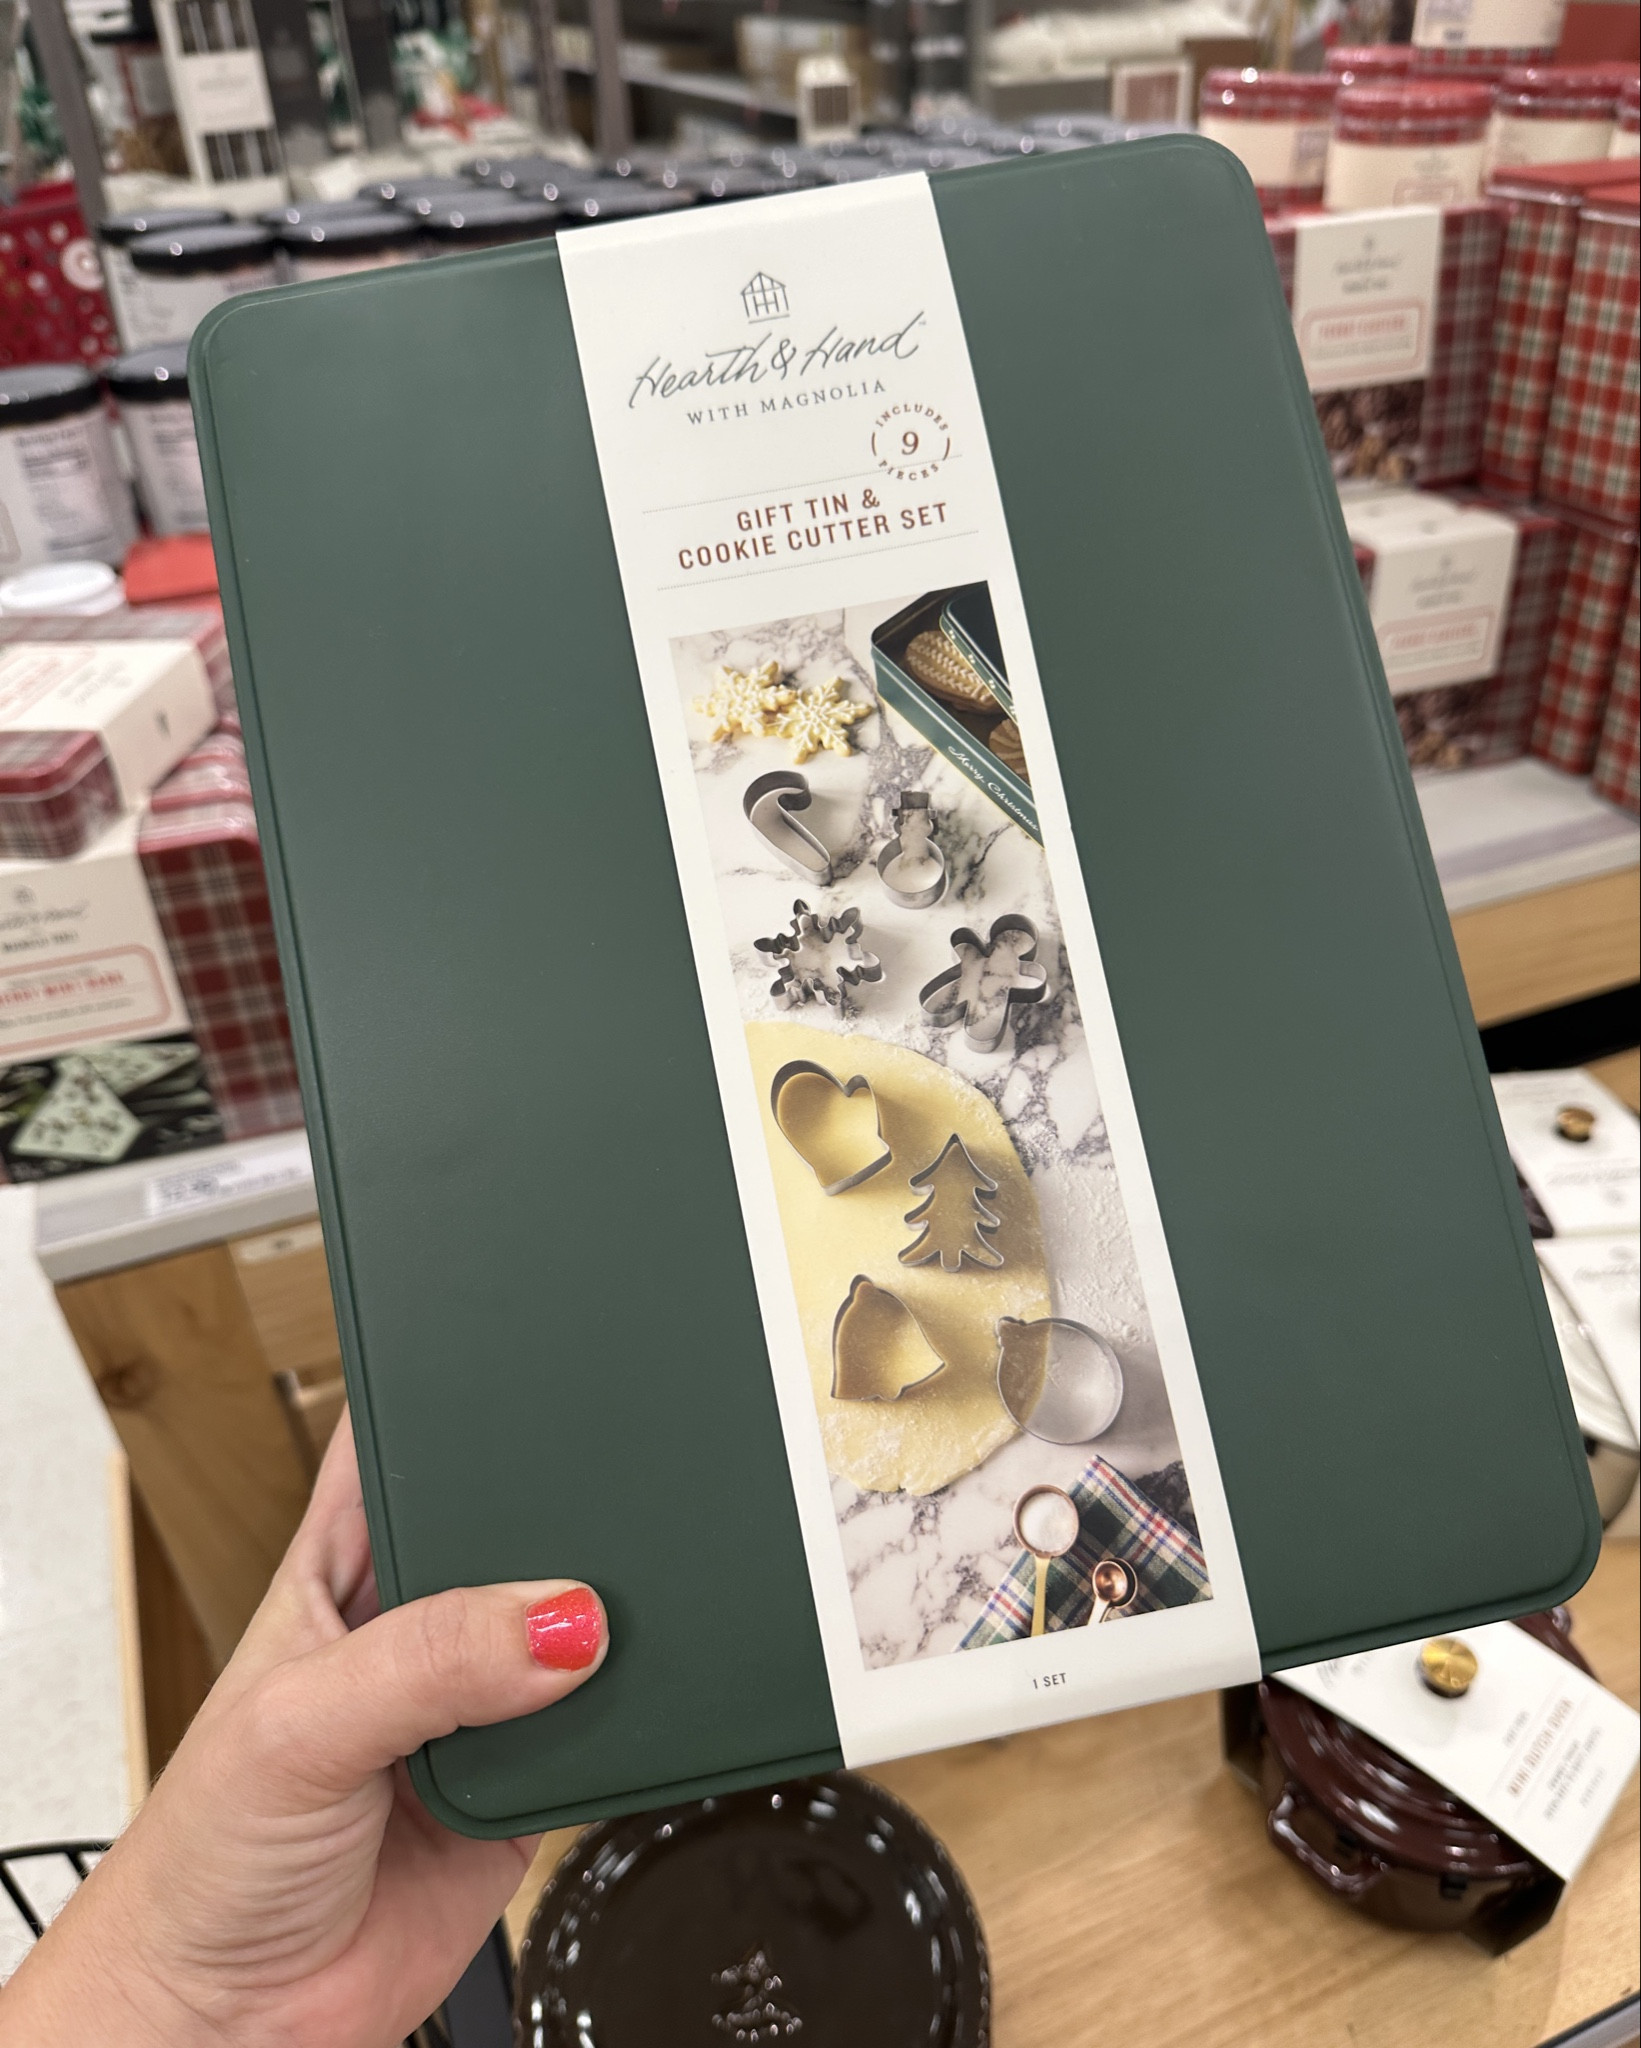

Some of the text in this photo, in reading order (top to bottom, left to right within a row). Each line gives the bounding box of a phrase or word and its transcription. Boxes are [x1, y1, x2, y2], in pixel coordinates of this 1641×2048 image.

[629, 311, 925, 409] Hearth & Hand
[686, 379, 887, 426] WITH MAGNOLIA
[875, 403, 949, 431] INCLUDES
[901, 431, 919, 456] 9
[878, 459, 939, 481] PIECES
[736, 488, 880, 532] GIFT TIN &
[678, 502, 948, 570] COOKIE CUTTER SET
[947, 745, 986, 784] Merry
[1042, 1672, 1067, 1688] SET
